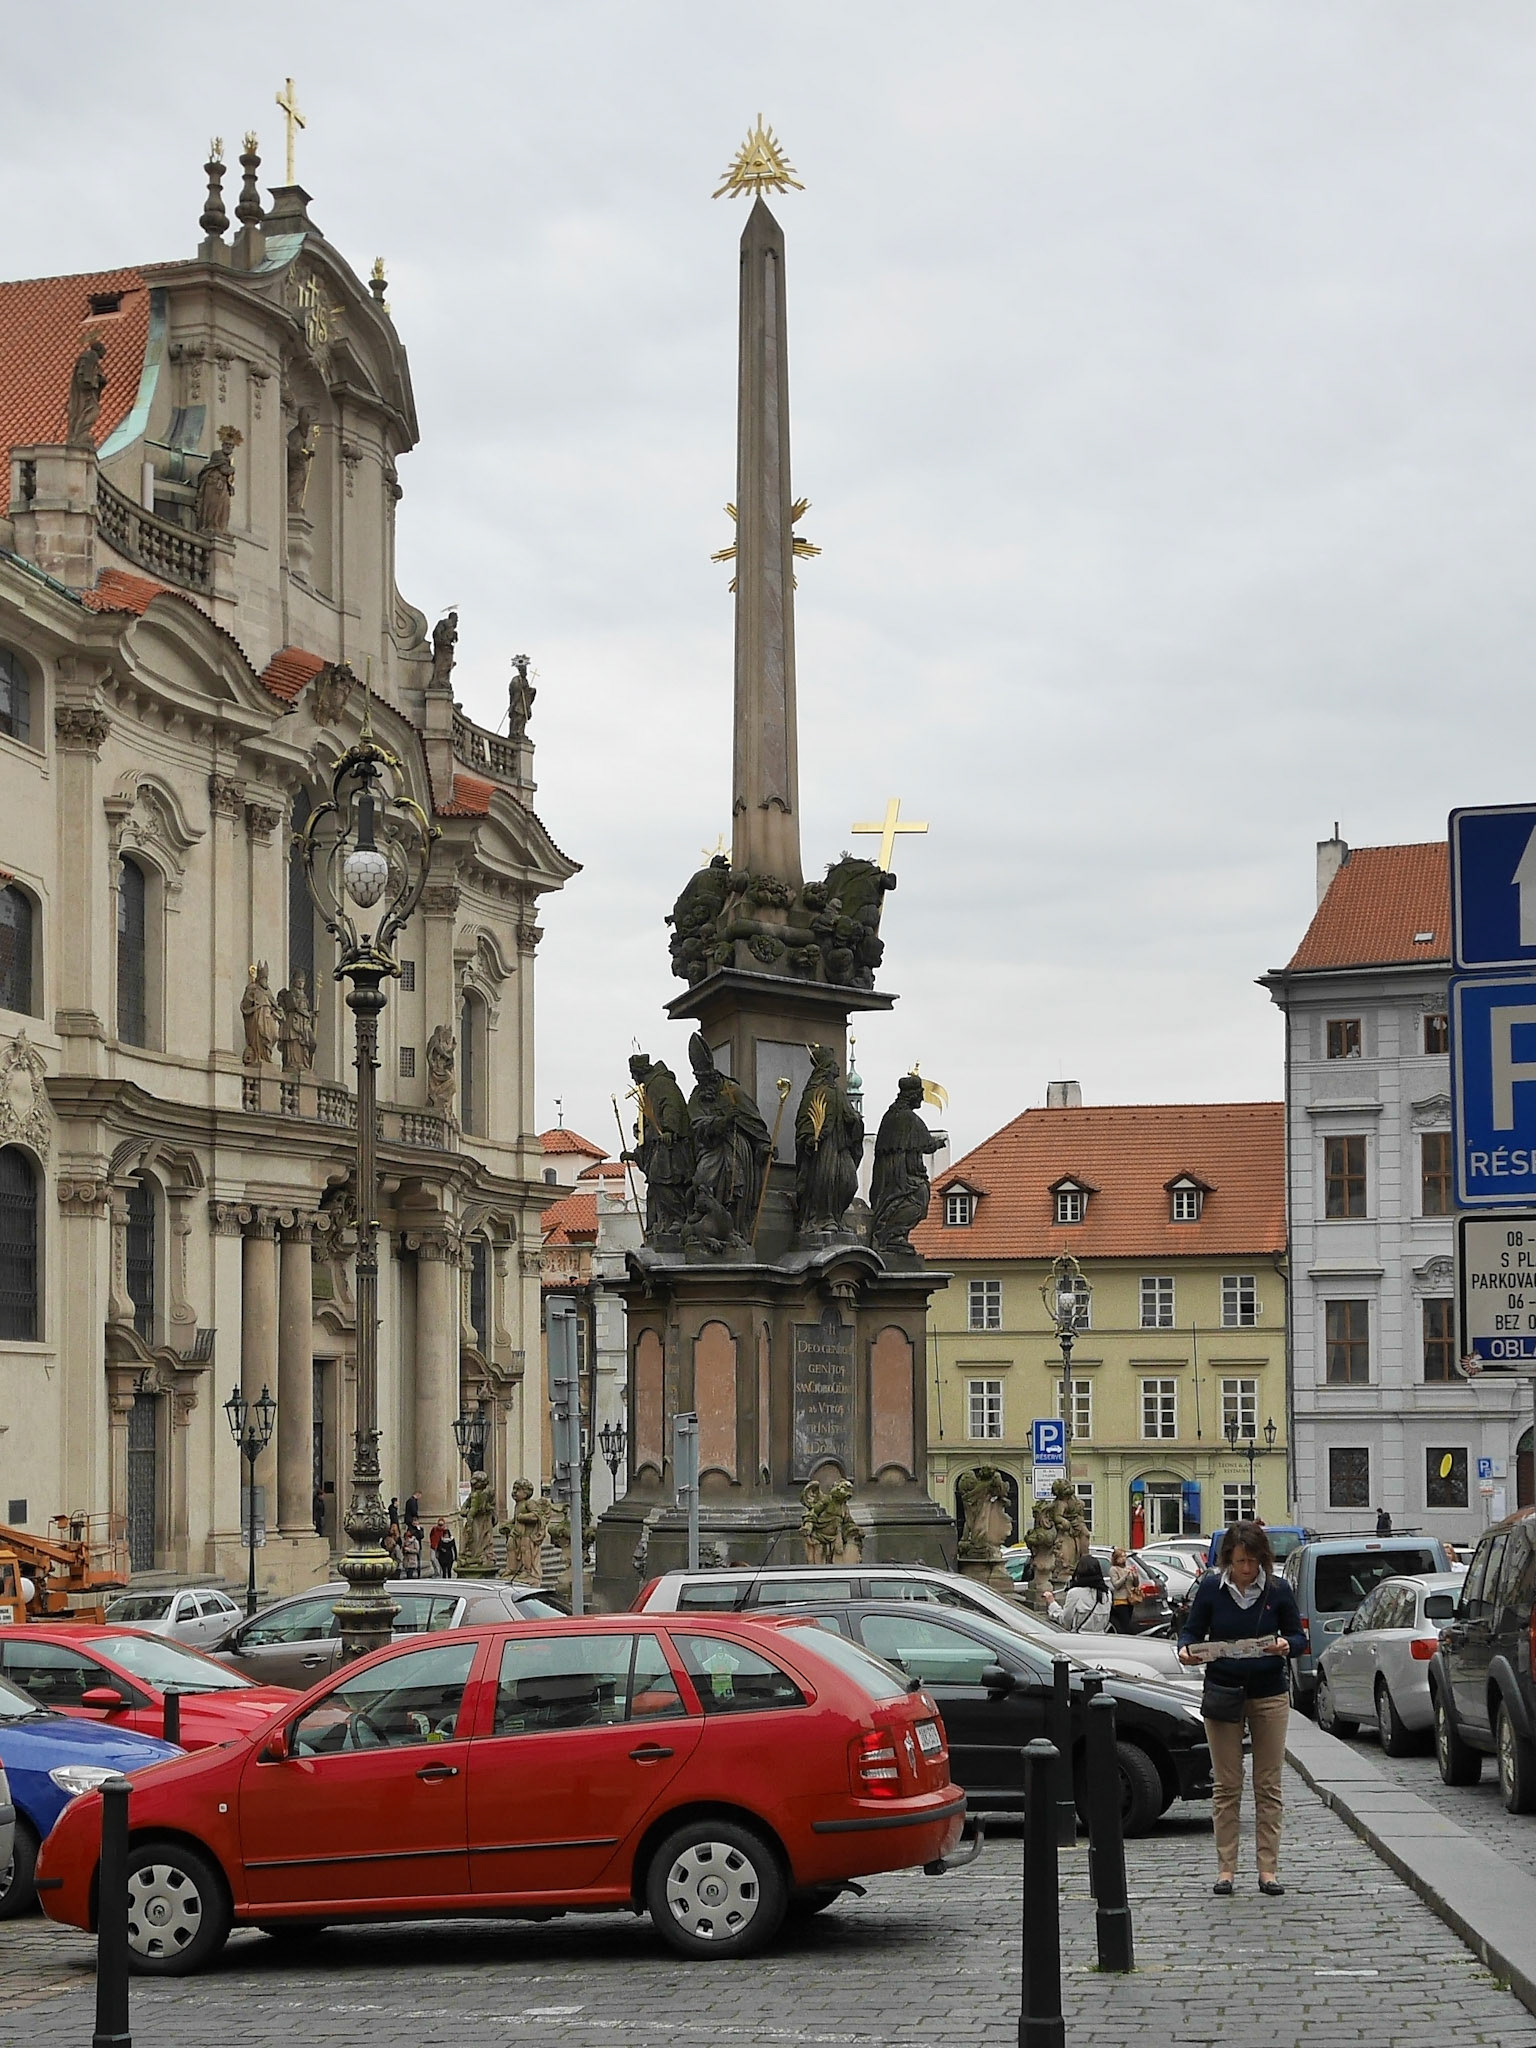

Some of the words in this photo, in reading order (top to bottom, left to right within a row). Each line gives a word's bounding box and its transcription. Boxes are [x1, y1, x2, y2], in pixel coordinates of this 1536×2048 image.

[1507, 1231, 1523, 1247] 08
[1501, 1252, 1509, 1268] S
[1518, 1251, 1536, 1268] PL
[1508, 1293, 1524, 1309] 06
[1496, 1314, 1520, 1331] BEZ
[1491, 1339, 1536, 1358] OBL
[1040, 1425, 1058, 1452] P
